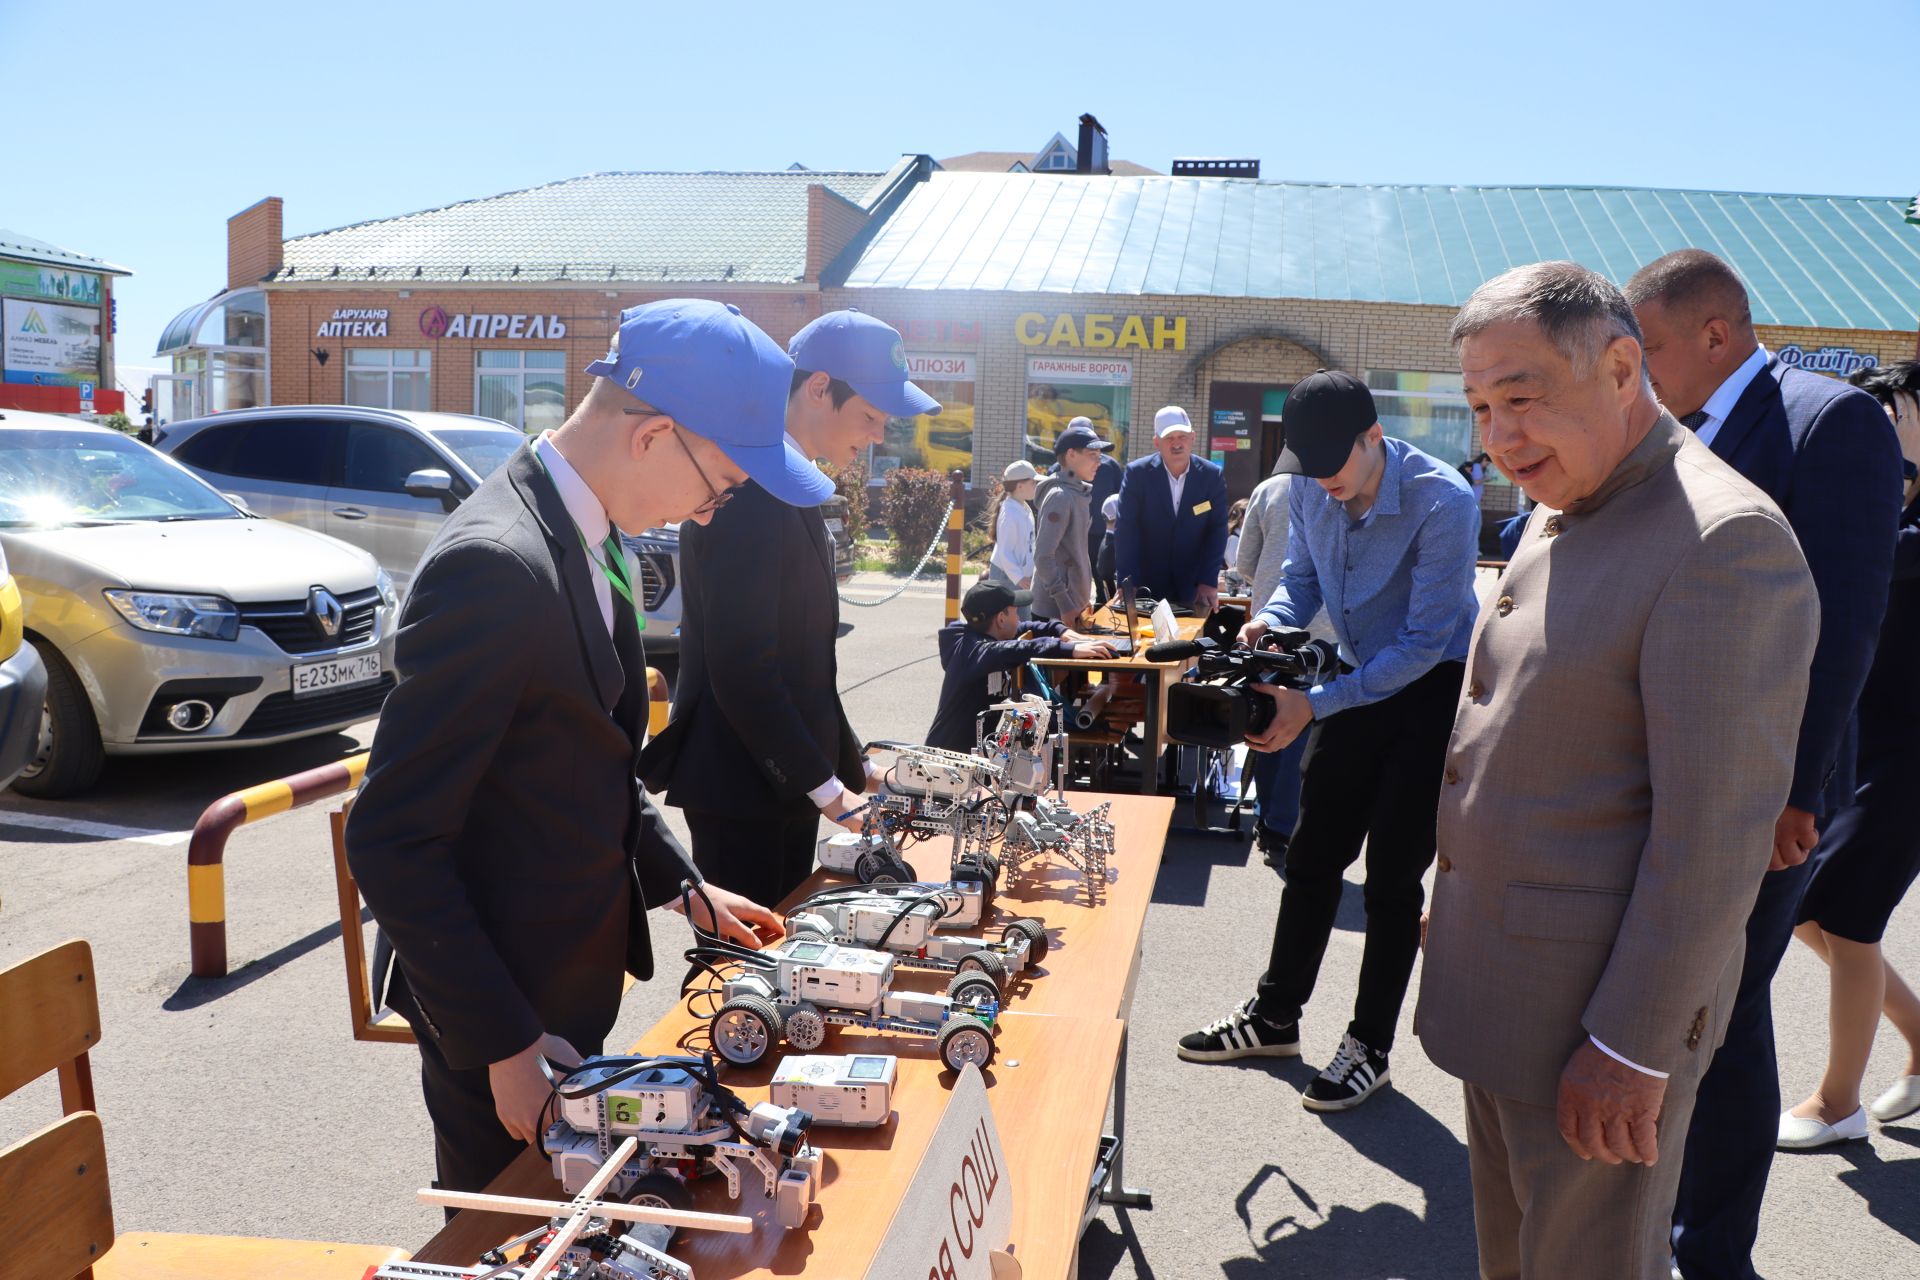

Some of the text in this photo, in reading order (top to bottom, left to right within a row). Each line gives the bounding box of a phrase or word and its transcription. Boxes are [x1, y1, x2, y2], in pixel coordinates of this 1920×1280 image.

[332, 309, 388, 319] ДАРУХАНӘ
[316, 321, 388, 336] АПТЕКА
[445, 314, 566, 338] АПРЕЛЬ
[1014, 311, 1187, 350] САБАН
[1032, 360, 1127, 374] ГАРАЖНЫЕ ВОРОТА
[358, 656, 378, 673] 716
[950, 1115, 999, 1260] СОШ
